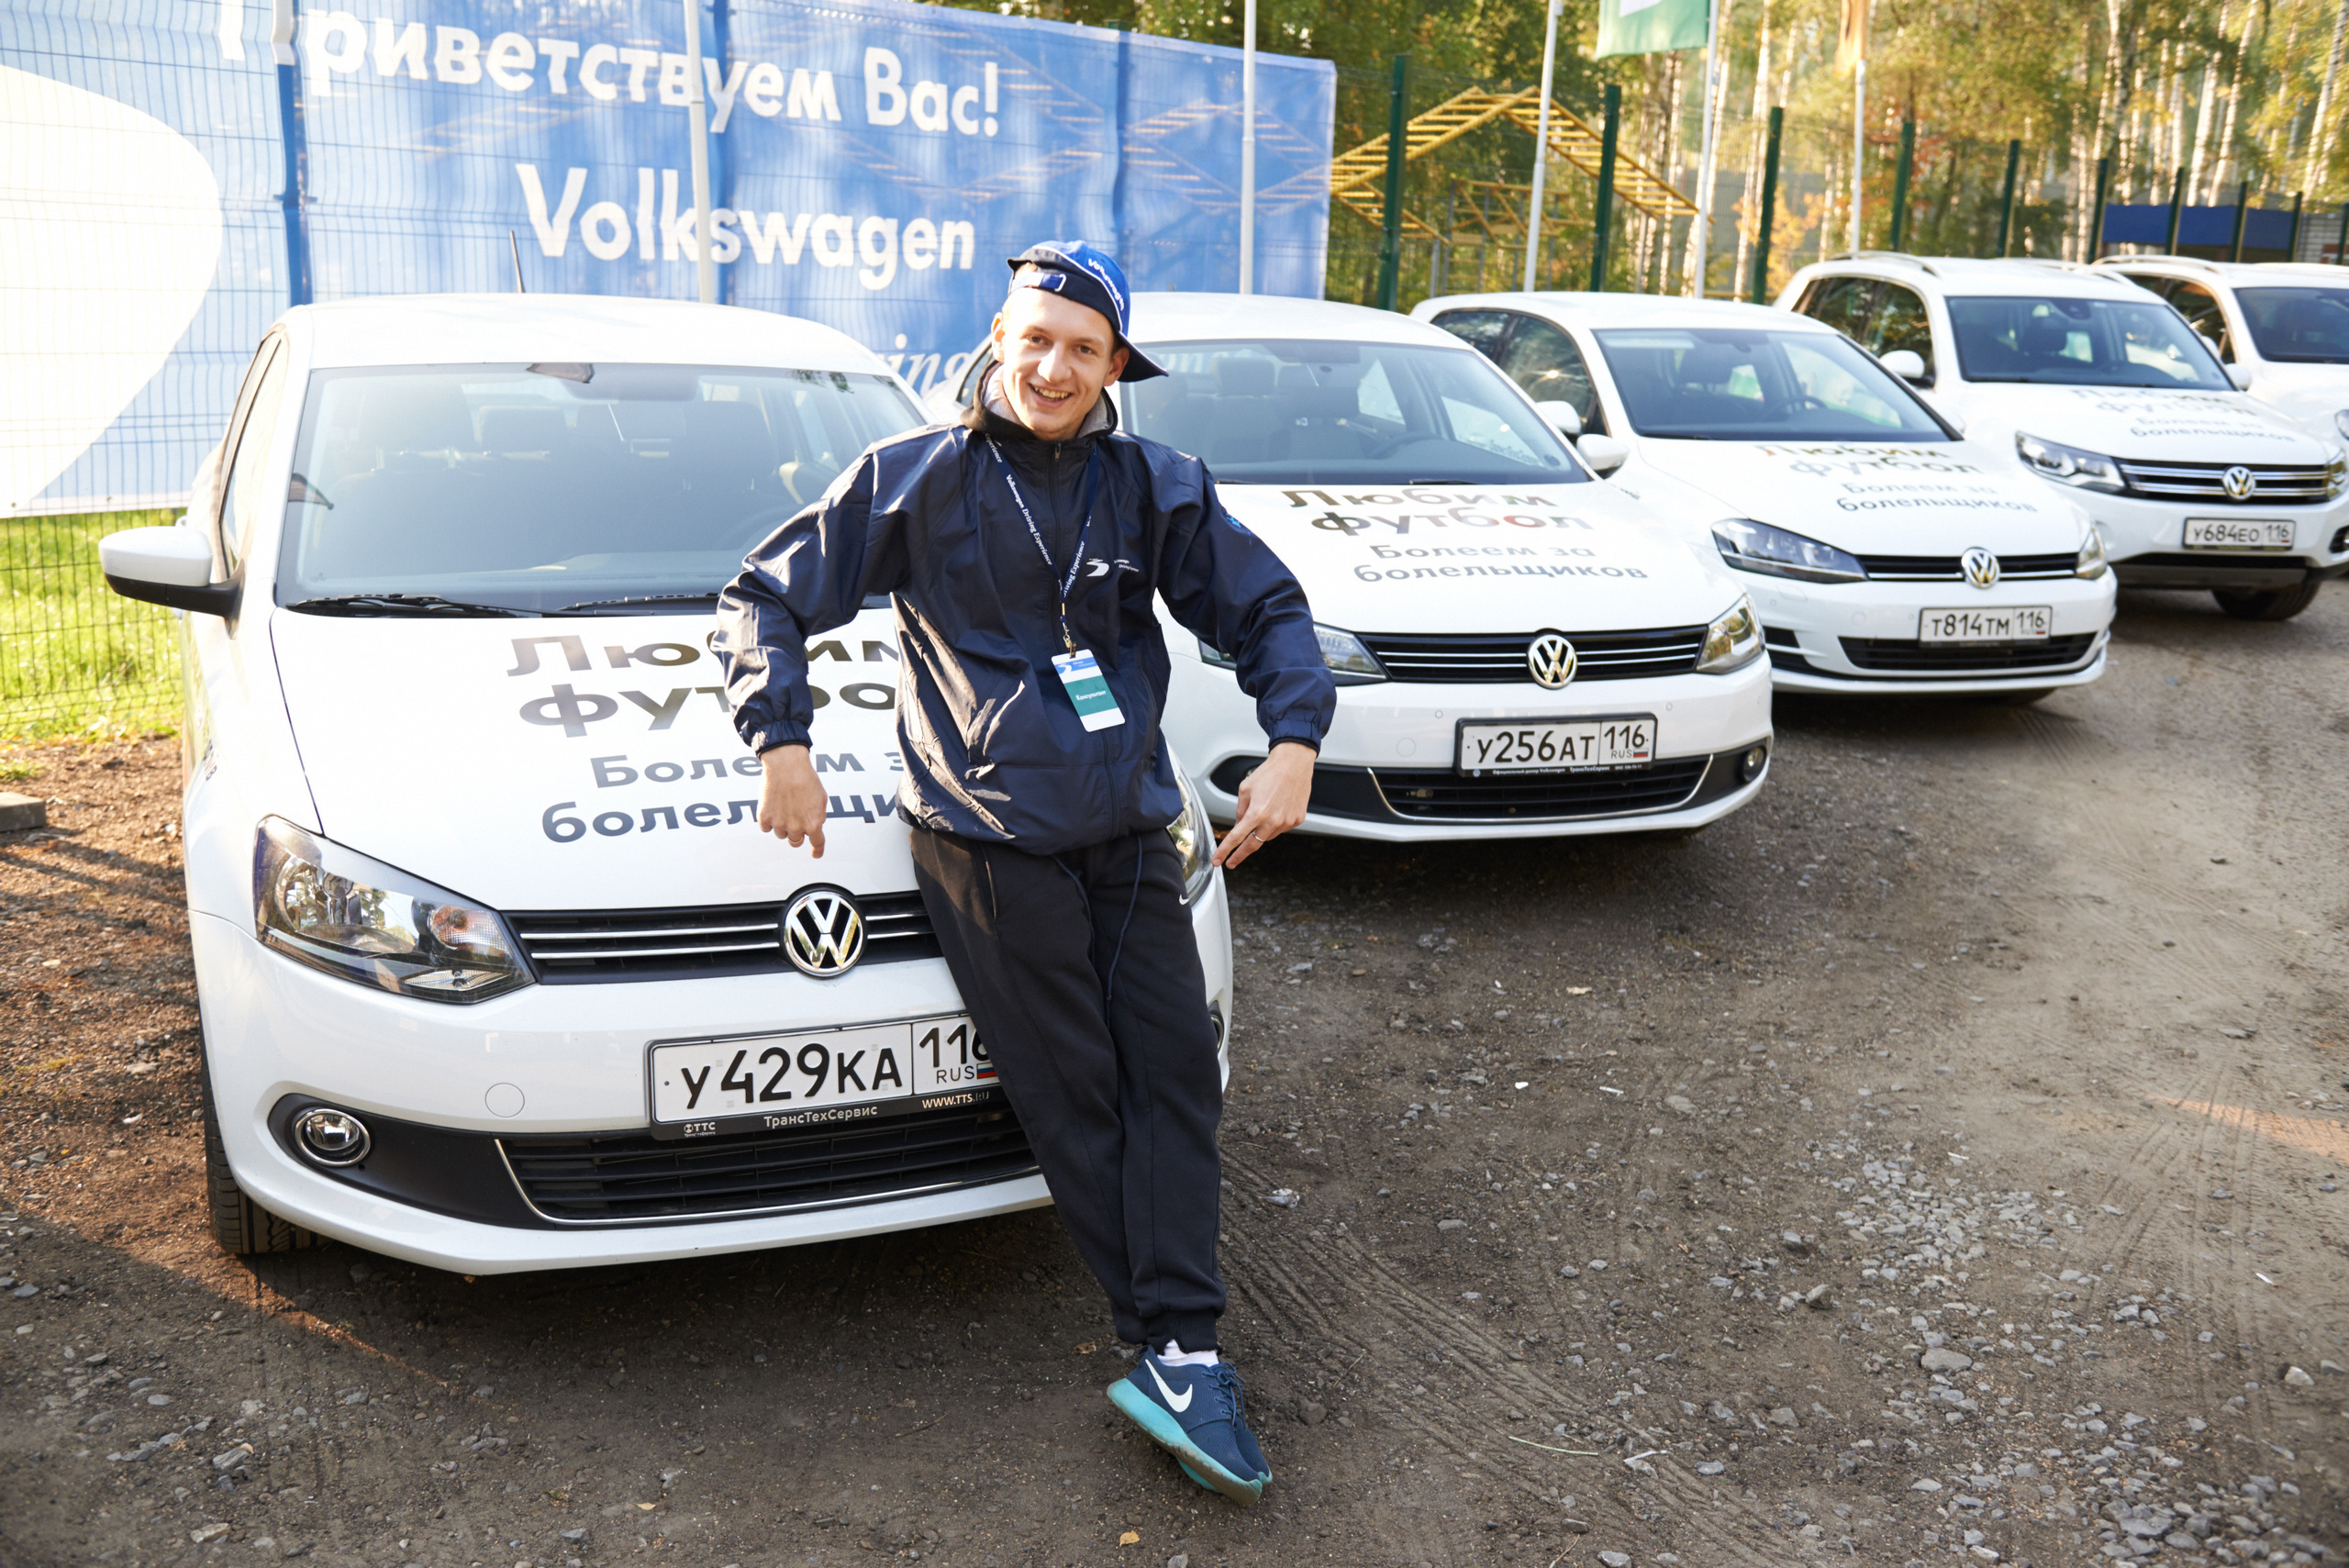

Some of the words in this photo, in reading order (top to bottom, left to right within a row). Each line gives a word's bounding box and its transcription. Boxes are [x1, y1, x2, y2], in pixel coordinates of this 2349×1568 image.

[864, 47, 998, 137] Вас!
[516, 163, 974, 290] Volkswagen
[1281, 488, 1558, 508] Любим
[1842, 483, 1959, 495] Болеем
[1836, 497, 2039, 512] болельщиков
[1022, 508, 1037, 533] Driving
[1033, 532, 1052, 565] Experience
[2265, 524, 2290, 539] 116
[1070, 540, 1085, 574] Experience
[1370, 544, 1538, 560] Болеем
[1549, 546, 1597, 557] за
[1353, 563, 1649, 583] болельщиков
[2017, 610, 2046, 628] 116
[507, 629, 898, 677] Люи
[1477, 730, 1596, 763] У256АТ
[1604, 724, 1645, 750] 116
[1611, 749, 1632, 760] RUS
[590, 753, 865, 788] Болем
[681, 1043, 903, 1109] У429КА
[936, 1065, 974, 1084] RUS
[922, 1091, 989, 1109] WWW.TTS.RU
[763, 1106, 878, 1129] ТрансТехСервис
